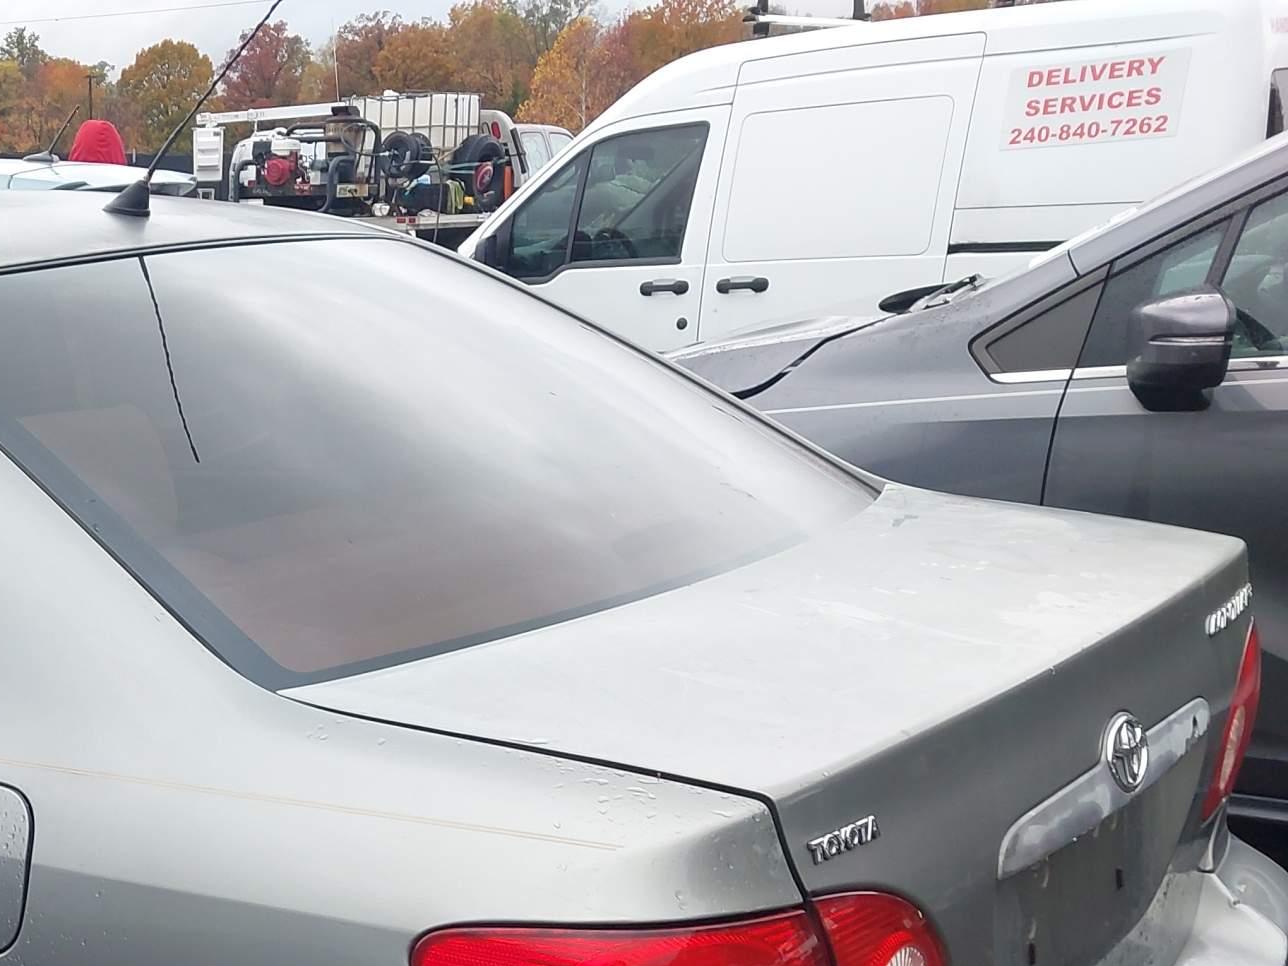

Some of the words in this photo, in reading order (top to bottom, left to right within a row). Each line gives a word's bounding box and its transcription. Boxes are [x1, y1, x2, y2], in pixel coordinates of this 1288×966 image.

[1027, 56, 1166, 88] DELIVERY
[1025, 87, 1162, 117] SERVICES
[1008, 115, 1169, 145] 240-840-7262
[807, 815, 880, 865] TOYOTA
